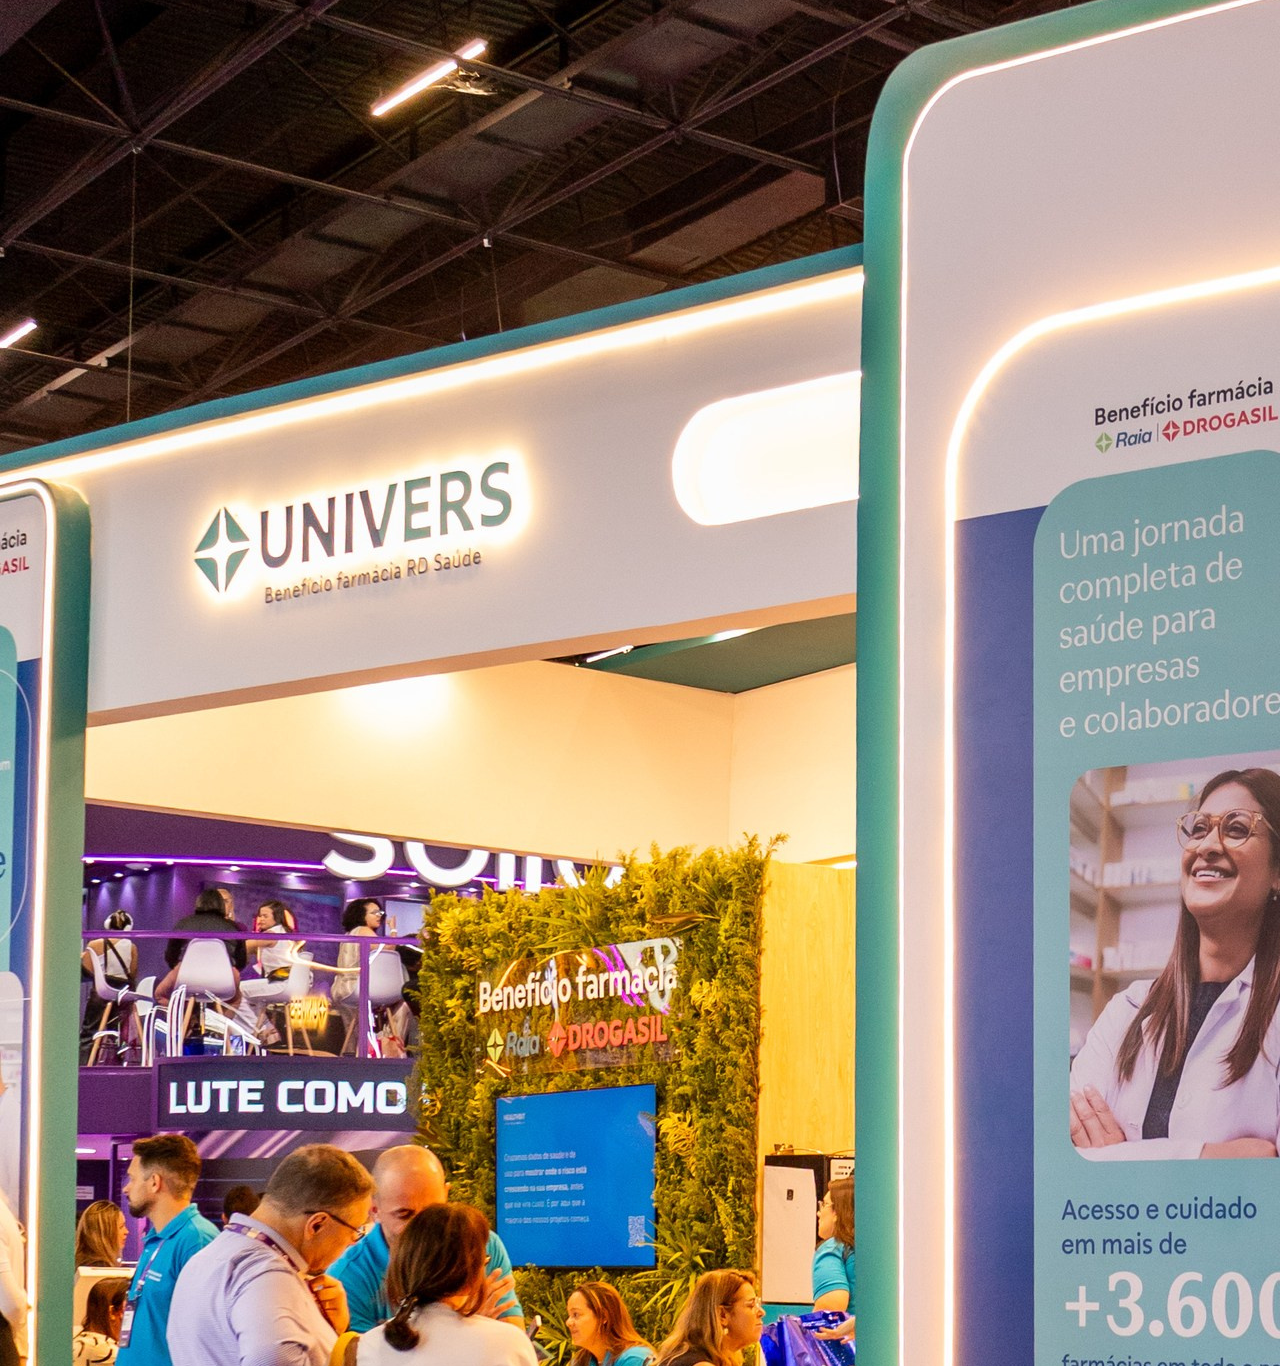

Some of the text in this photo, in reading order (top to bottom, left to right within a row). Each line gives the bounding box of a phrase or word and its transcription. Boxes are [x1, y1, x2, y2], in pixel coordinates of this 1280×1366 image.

[1094, 377, 1274, 426] Benefício farmácia
[1115, 406, 1279, 449] Raia DROGASIL
[259, 461, 513, 569] UNIVERS
[1059, 504, 1245, 560] Uma jornada
[0, 556, 30, 575] ASIL
[264, 548, 482, 604] Benefício farmácia RD Saúde
[1059, 552, 1243, 605] completa de
[1059, 605, 1217, 649] saúde para
[1059, 652, 1200, 695] empresas
[1059, 715, 1076, 738] e
[479, 956, 678, 1014] Benefício farmácia
[567, 1015, 668, 1051] DROGASIL
[168, 1079, 408, 1114] LUTE COMO
[1061, 1195, 1258, 1222] Acesso e cuidado
[1061, 1231, 1187, 1255] em mais de
